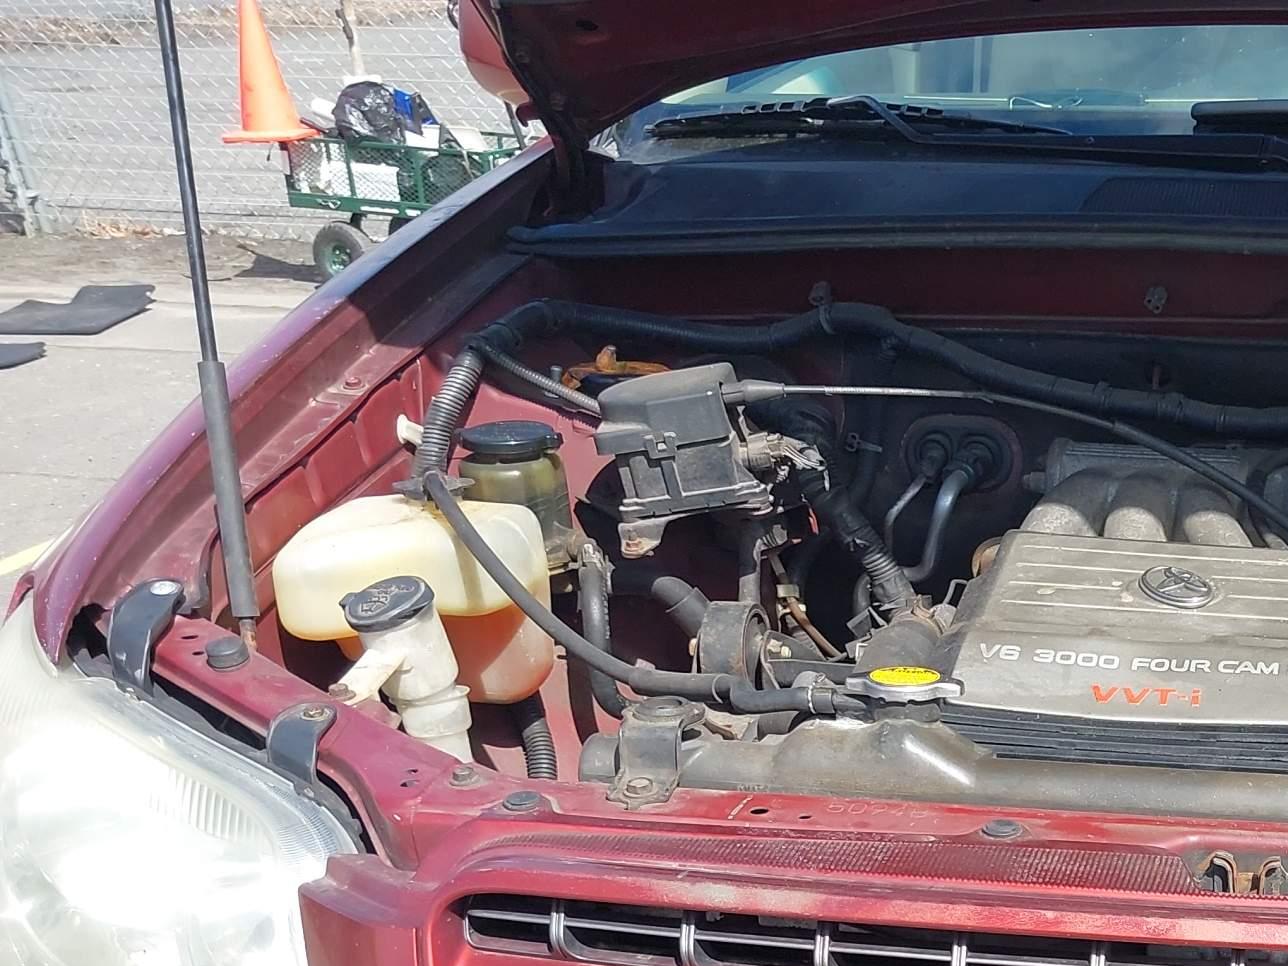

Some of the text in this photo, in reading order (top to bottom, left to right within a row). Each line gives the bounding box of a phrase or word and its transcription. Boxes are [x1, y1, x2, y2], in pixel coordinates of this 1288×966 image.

[979, 642, 1022, 662] V6
[1032, 648, 1120, 670] 3000
[1131, 656, 1212, 675] FOUR
[1217, 659, 1280, 676] CAM
[1090, 684, 1203, 708] VVT-i
